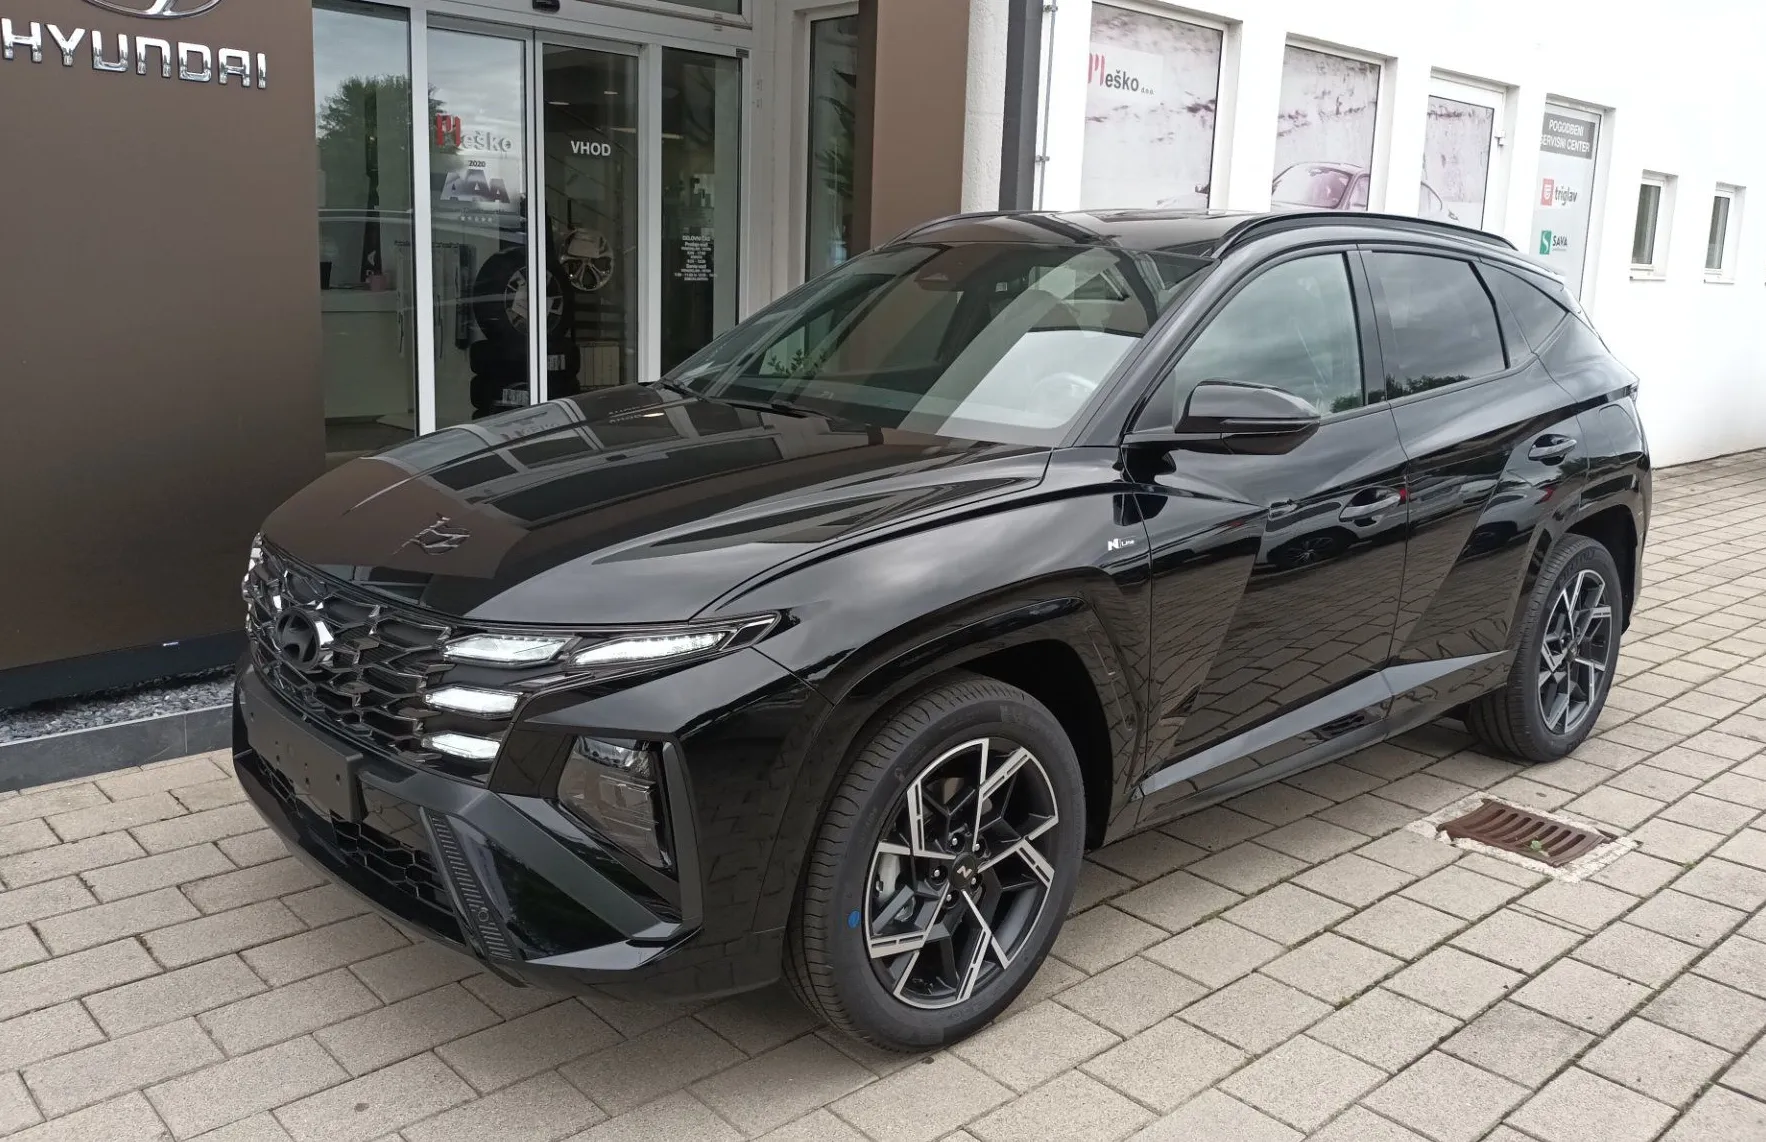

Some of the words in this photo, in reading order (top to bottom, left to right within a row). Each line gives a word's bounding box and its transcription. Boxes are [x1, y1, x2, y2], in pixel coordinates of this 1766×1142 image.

[1, 17, 267, 90] HYUNDAI
[1548, 119, 1585, 137] POGODBENI
[570, 140, 612, 156] VHOD
[1566, 138, 1591, 153] CENTER
[468, 159, 486, 168] 2020
[1555, 185, 1577, 206] triglav
[1552, 235, 1568, 247] SAVA
